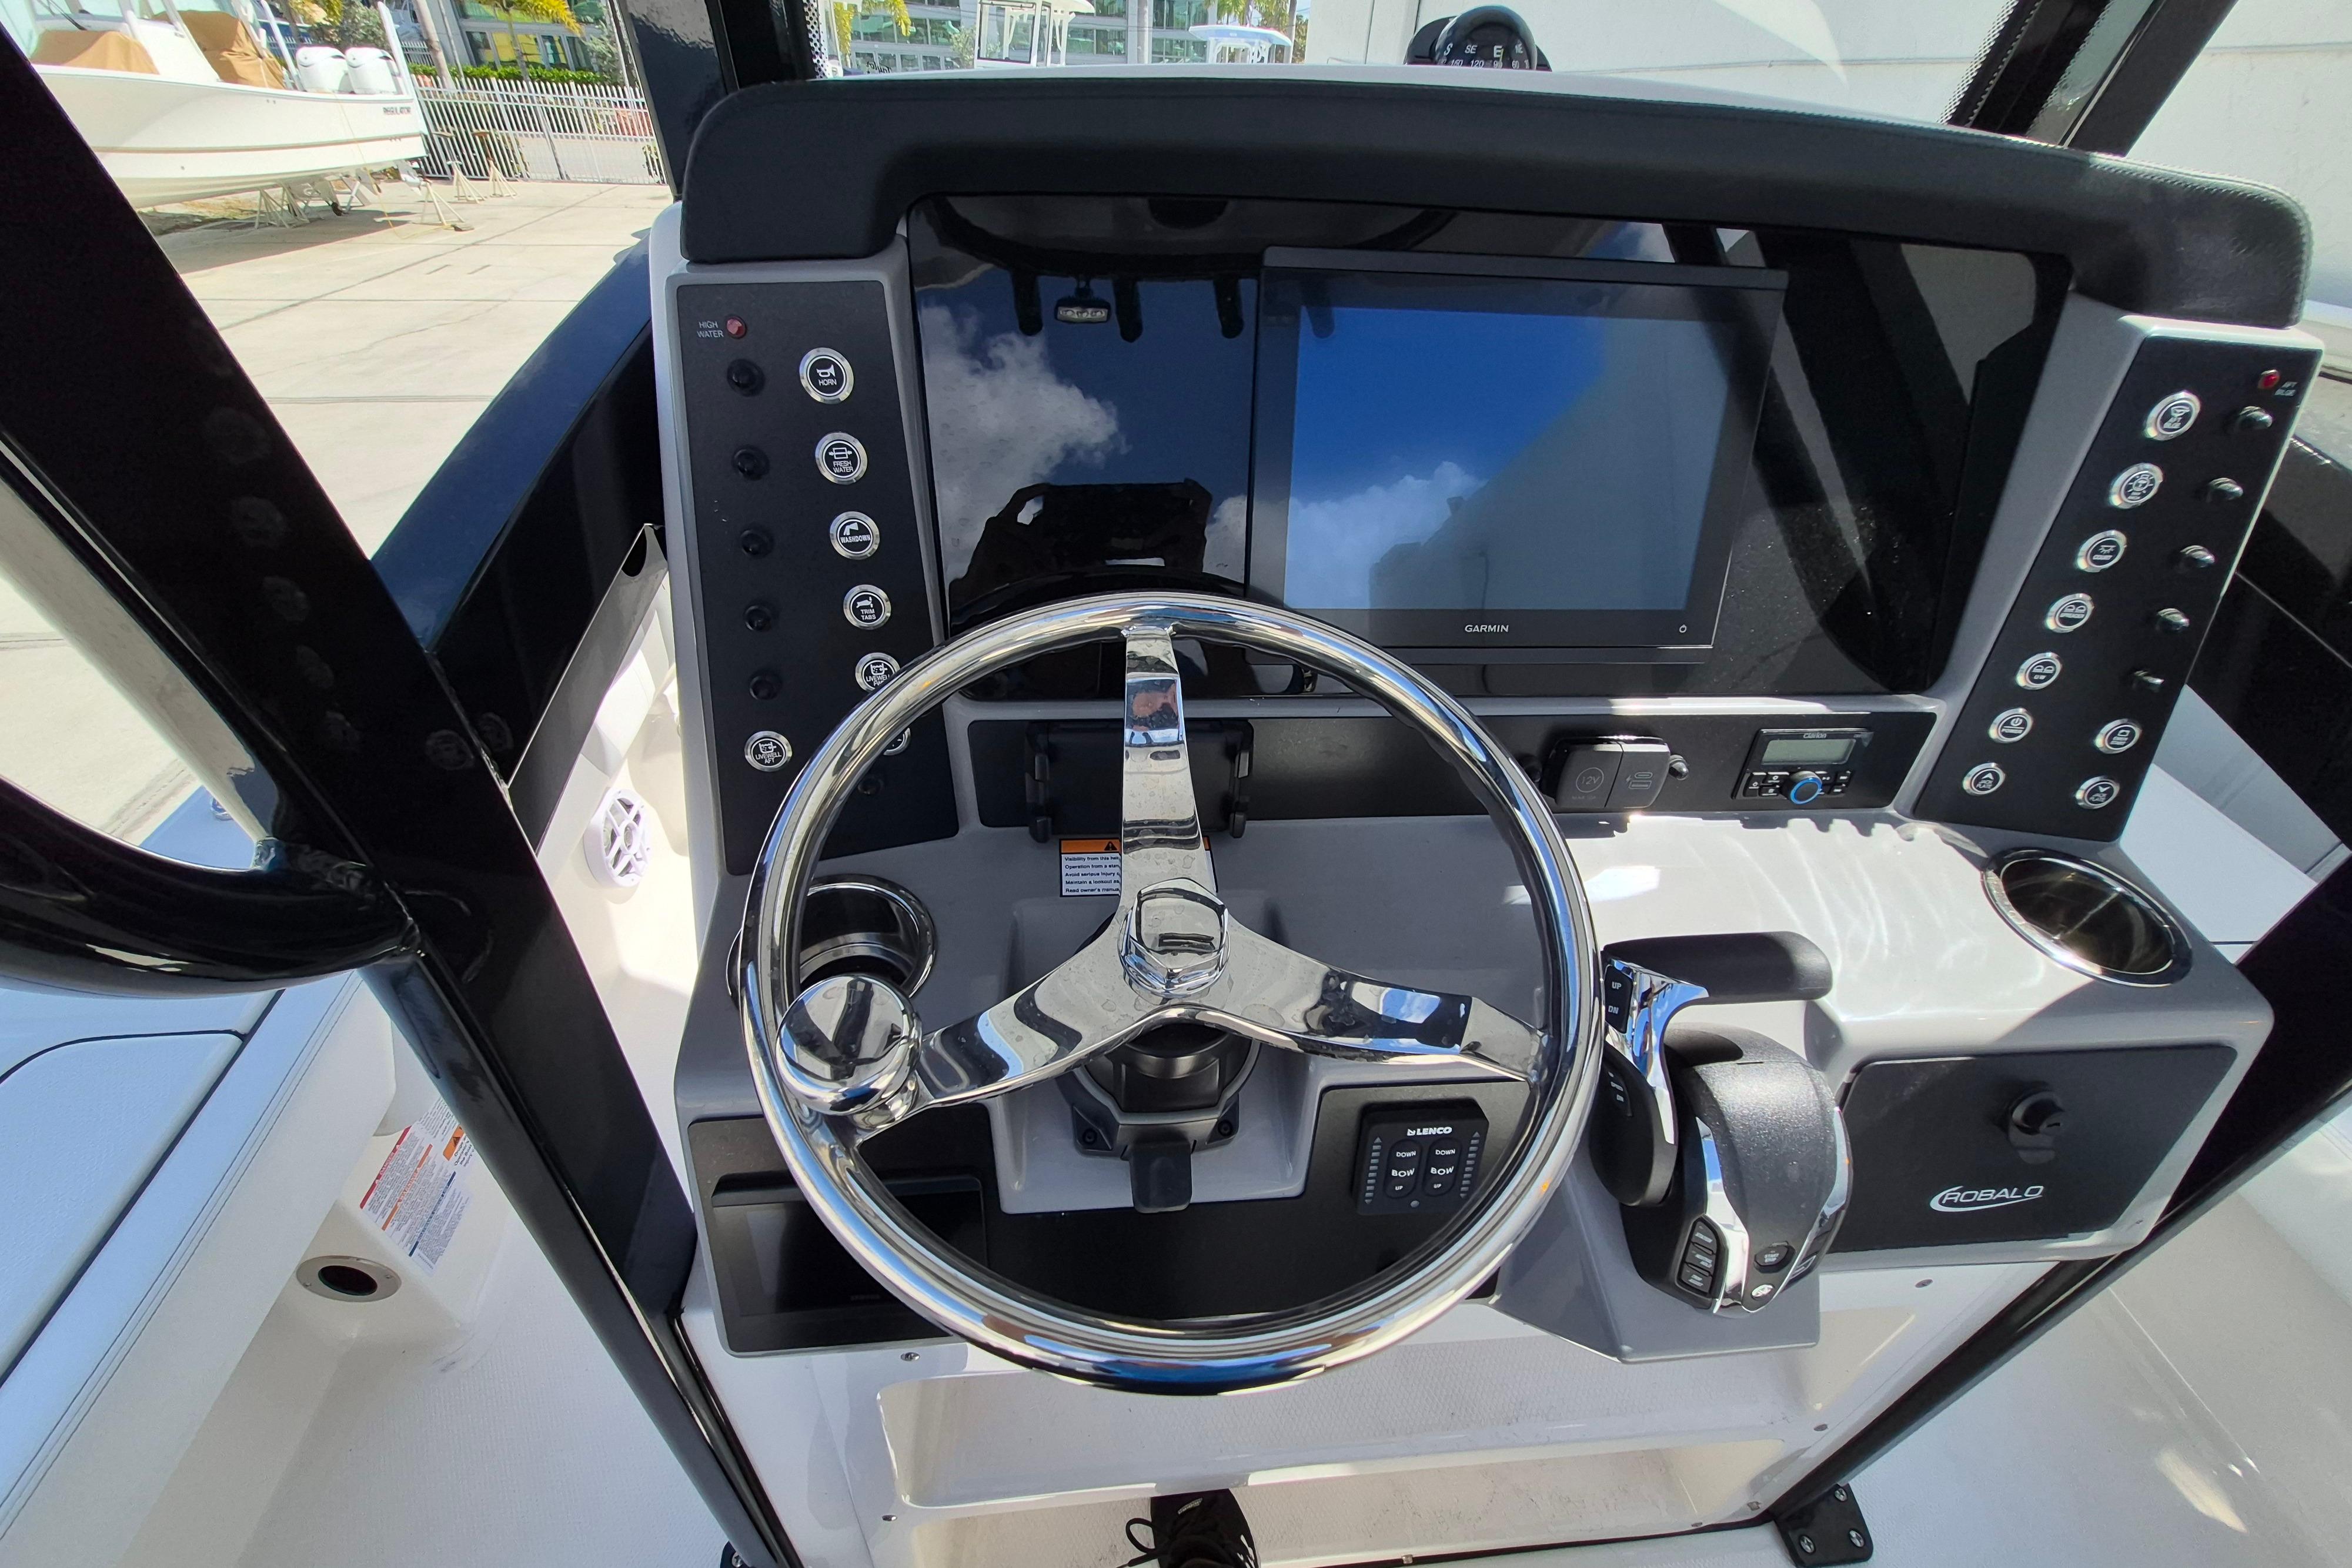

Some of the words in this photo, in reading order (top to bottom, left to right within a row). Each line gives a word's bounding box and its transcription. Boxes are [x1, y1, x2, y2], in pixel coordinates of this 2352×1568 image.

[1444, 42, 1453, 56] S
[1465, 45, 1478, 54] SE
[1494, 45, 1502, 58] E
[1471, 59, 1485, 68] 120
[1512, 60, 1519, 69] 60
[840, 534, 871, 543] WASHDOWN
[1465, 624, 1509, 633] GARMIN
[755, 751, 782, 760] LIVEWELL
[1582, 776, 1600, 785] 12V
[1612, 981, 1622, 989] UP
[1608, 1005, 1619, 1014] DN
[1416, 1126, 1452, 1136] LENCO
[1391, 1168, 1415, 1177] BOW
[1430, 1166, 1454, 1175] BOW
[1942, 1185, 2044, 1204] ROBALO
